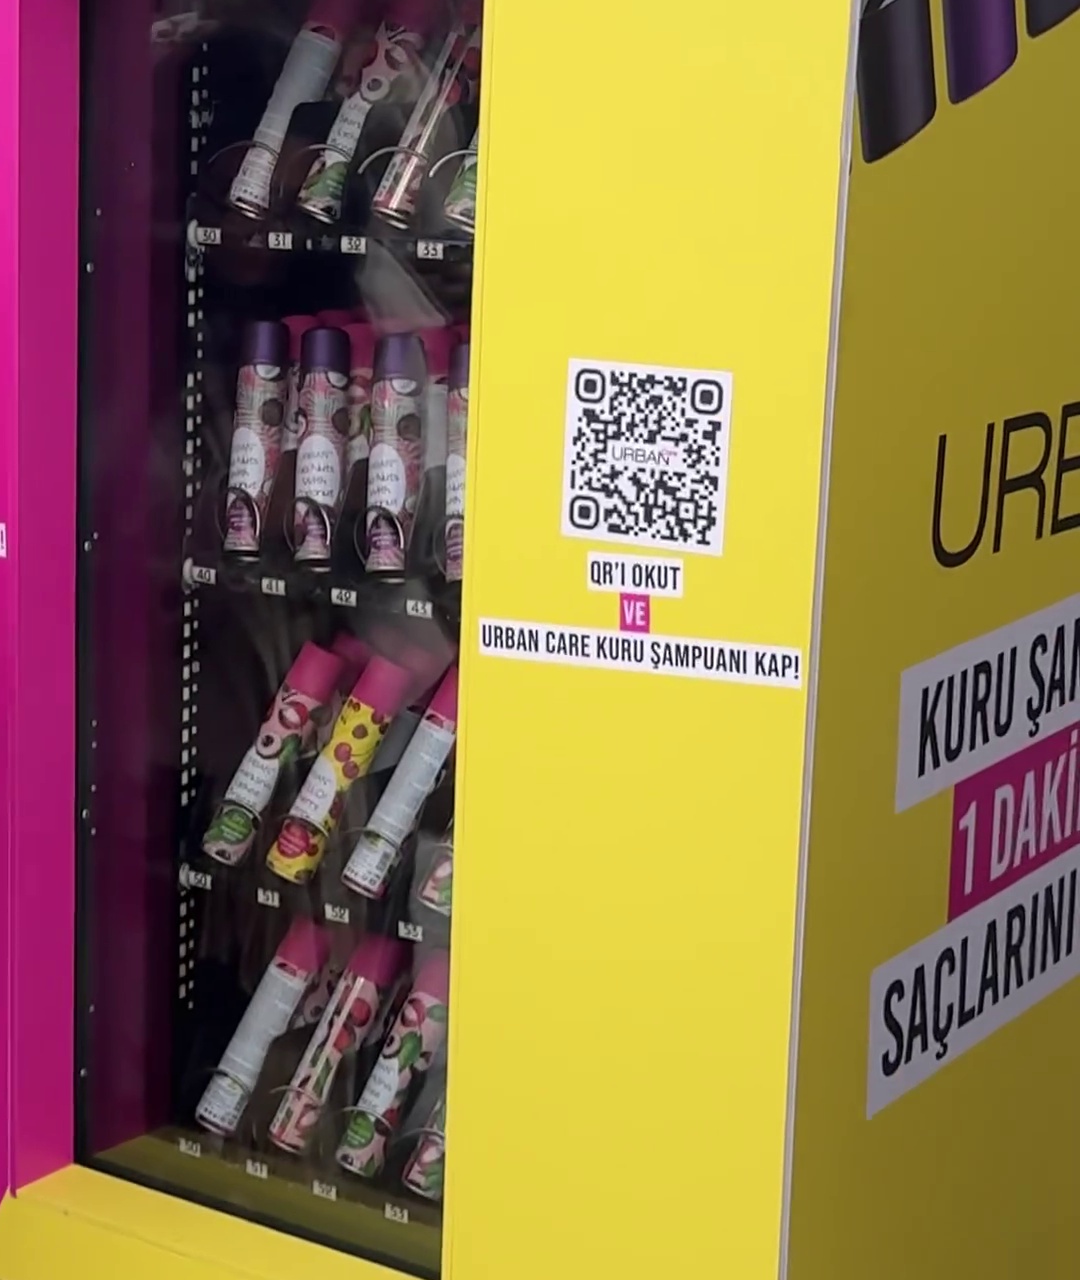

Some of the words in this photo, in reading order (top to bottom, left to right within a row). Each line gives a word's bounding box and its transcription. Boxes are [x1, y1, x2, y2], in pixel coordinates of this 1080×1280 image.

[612, 445, 669, 465] URBAN
[631, 564, 681, 591] OKUT
[622, 599, 648, 627] VE
[482, 624, 540, 654] URBAN
[545, 631, 590, 658] CARE
[596, 636, 645, 664] KURU
[650, 644, 748, 675] ŞAMPUANI
[755, 652, 800, 680] KAP!
[918, 646, 1017, 778] KURU
[959, 800, 977, 896] 1
[989, 728, 1080, 882] DAKİ
[881, 868, 1077, 1077] SAÇLARINI
